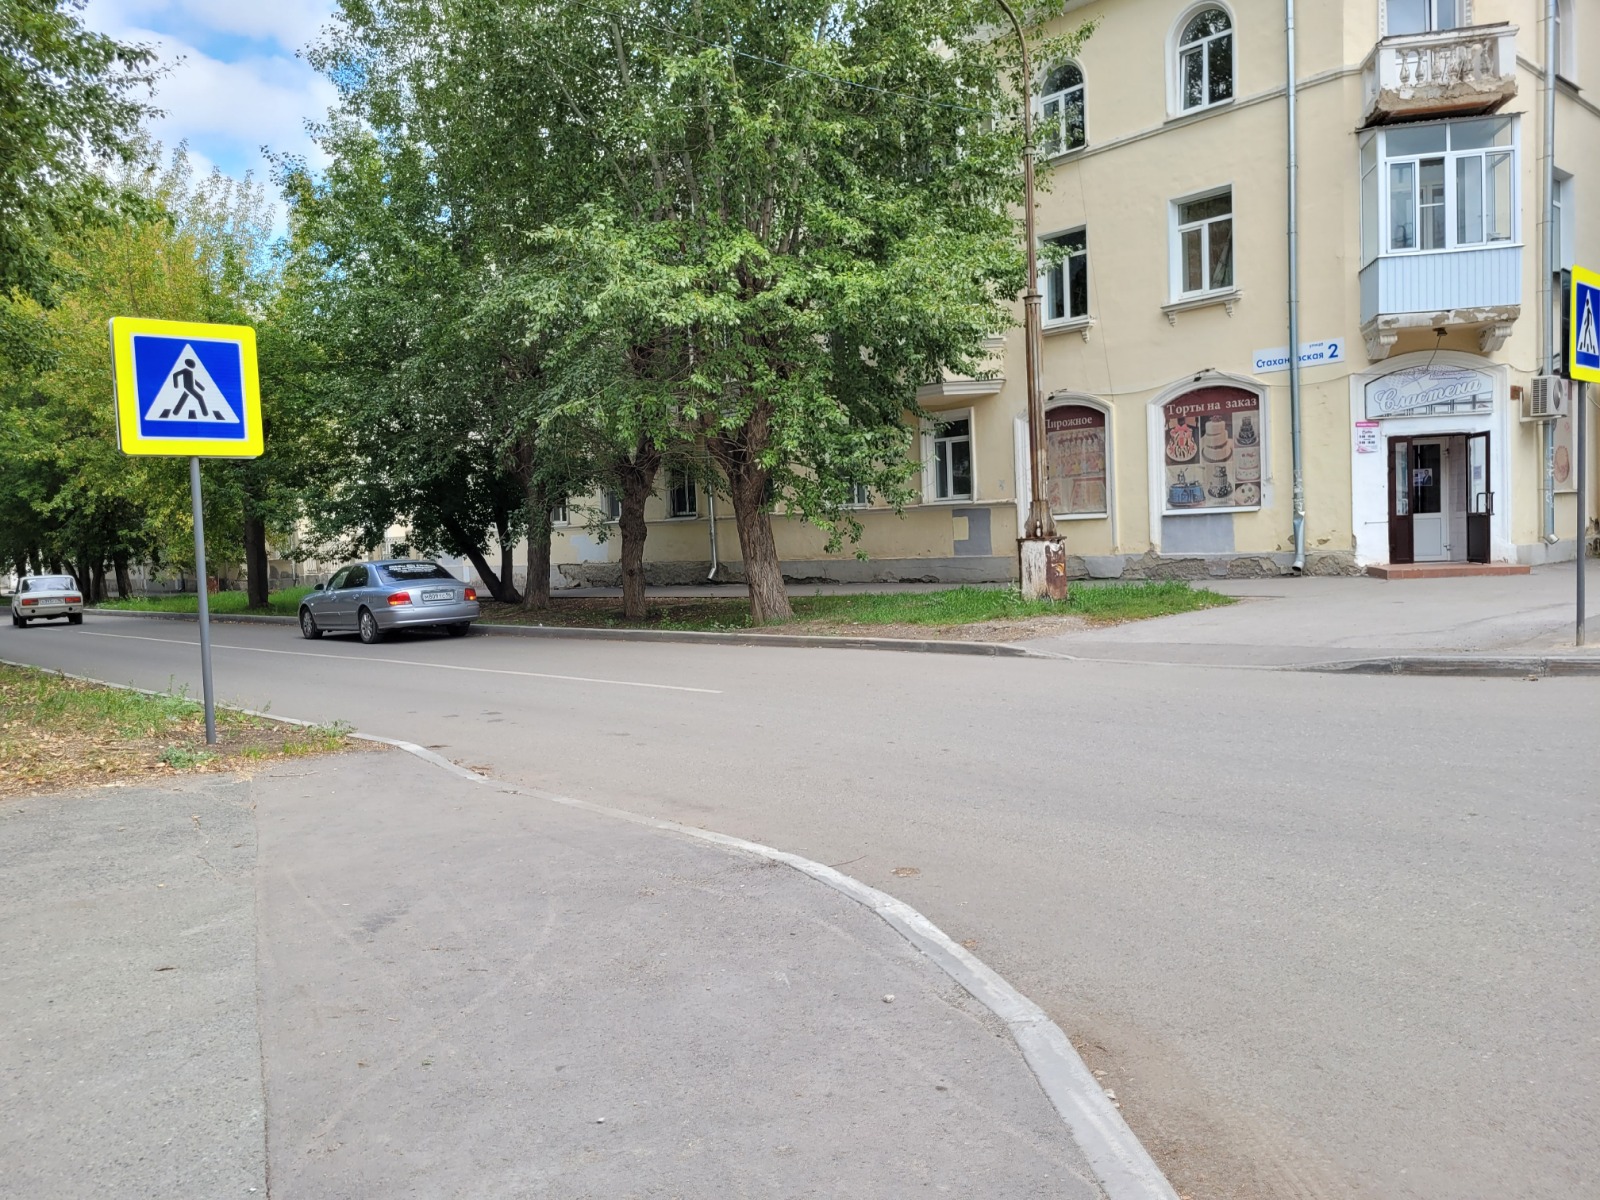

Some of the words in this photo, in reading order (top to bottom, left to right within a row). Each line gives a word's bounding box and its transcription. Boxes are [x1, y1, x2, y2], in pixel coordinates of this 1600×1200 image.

[1256, 352, 1324, 368] Стаханвская
[1328, 343, 1339, 359] 2
[1166, 404, 1205, 417] Торты
[1207, 402, 1221, 411] на
[1225, 397, 1257, 408] заказ
[1374, 379, 1481, 412] Сластена
